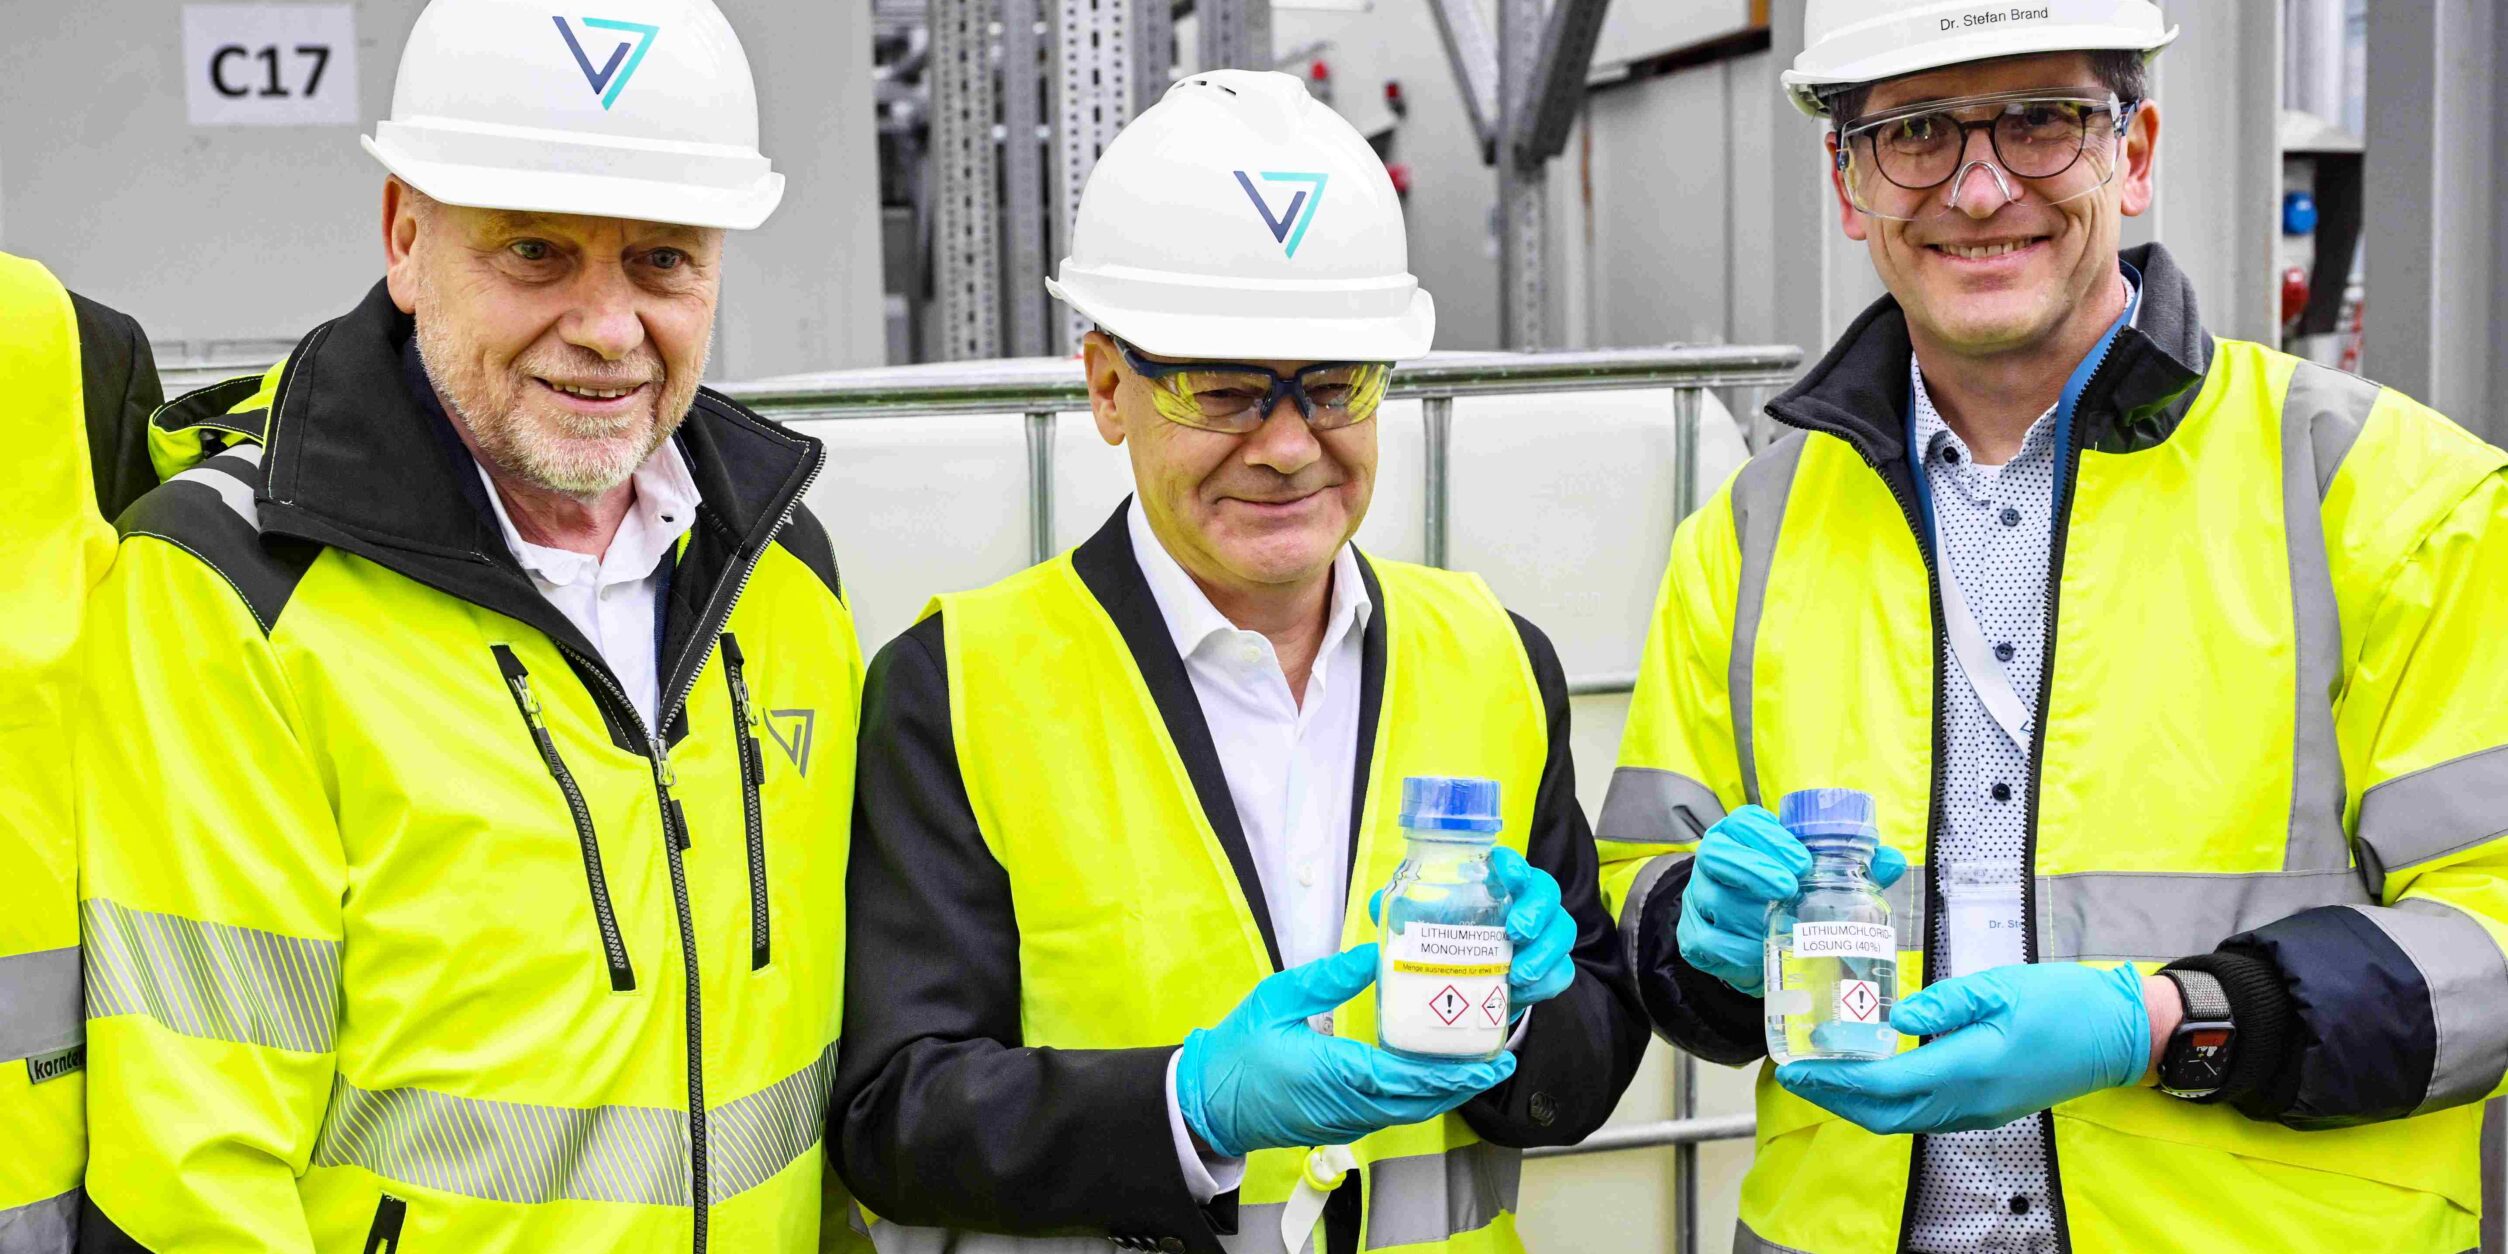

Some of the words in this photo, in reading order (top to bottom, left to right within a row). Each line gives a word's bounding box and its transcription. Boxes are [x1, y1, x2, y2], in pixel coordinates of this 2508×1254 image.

[1940, 18, 1959, 31] Dr.
[1963, 11, 2007, 27] Stefan
[2010, 7, 2049, 21] Brand
[210, 45, 331, 99] C17
[1989, 920, 2004, 929] Dr.
[1420, 927, 1509, 942] LITHIUMHYDROX
[1802, 925, 1892, 940] LITHIUMCHLORID-
[1420, 943, 1500, 957] MONOHYDRAT
[1855, 941, 1881, 953] (40%)
[34, 1050, 86, 1080] kornte
